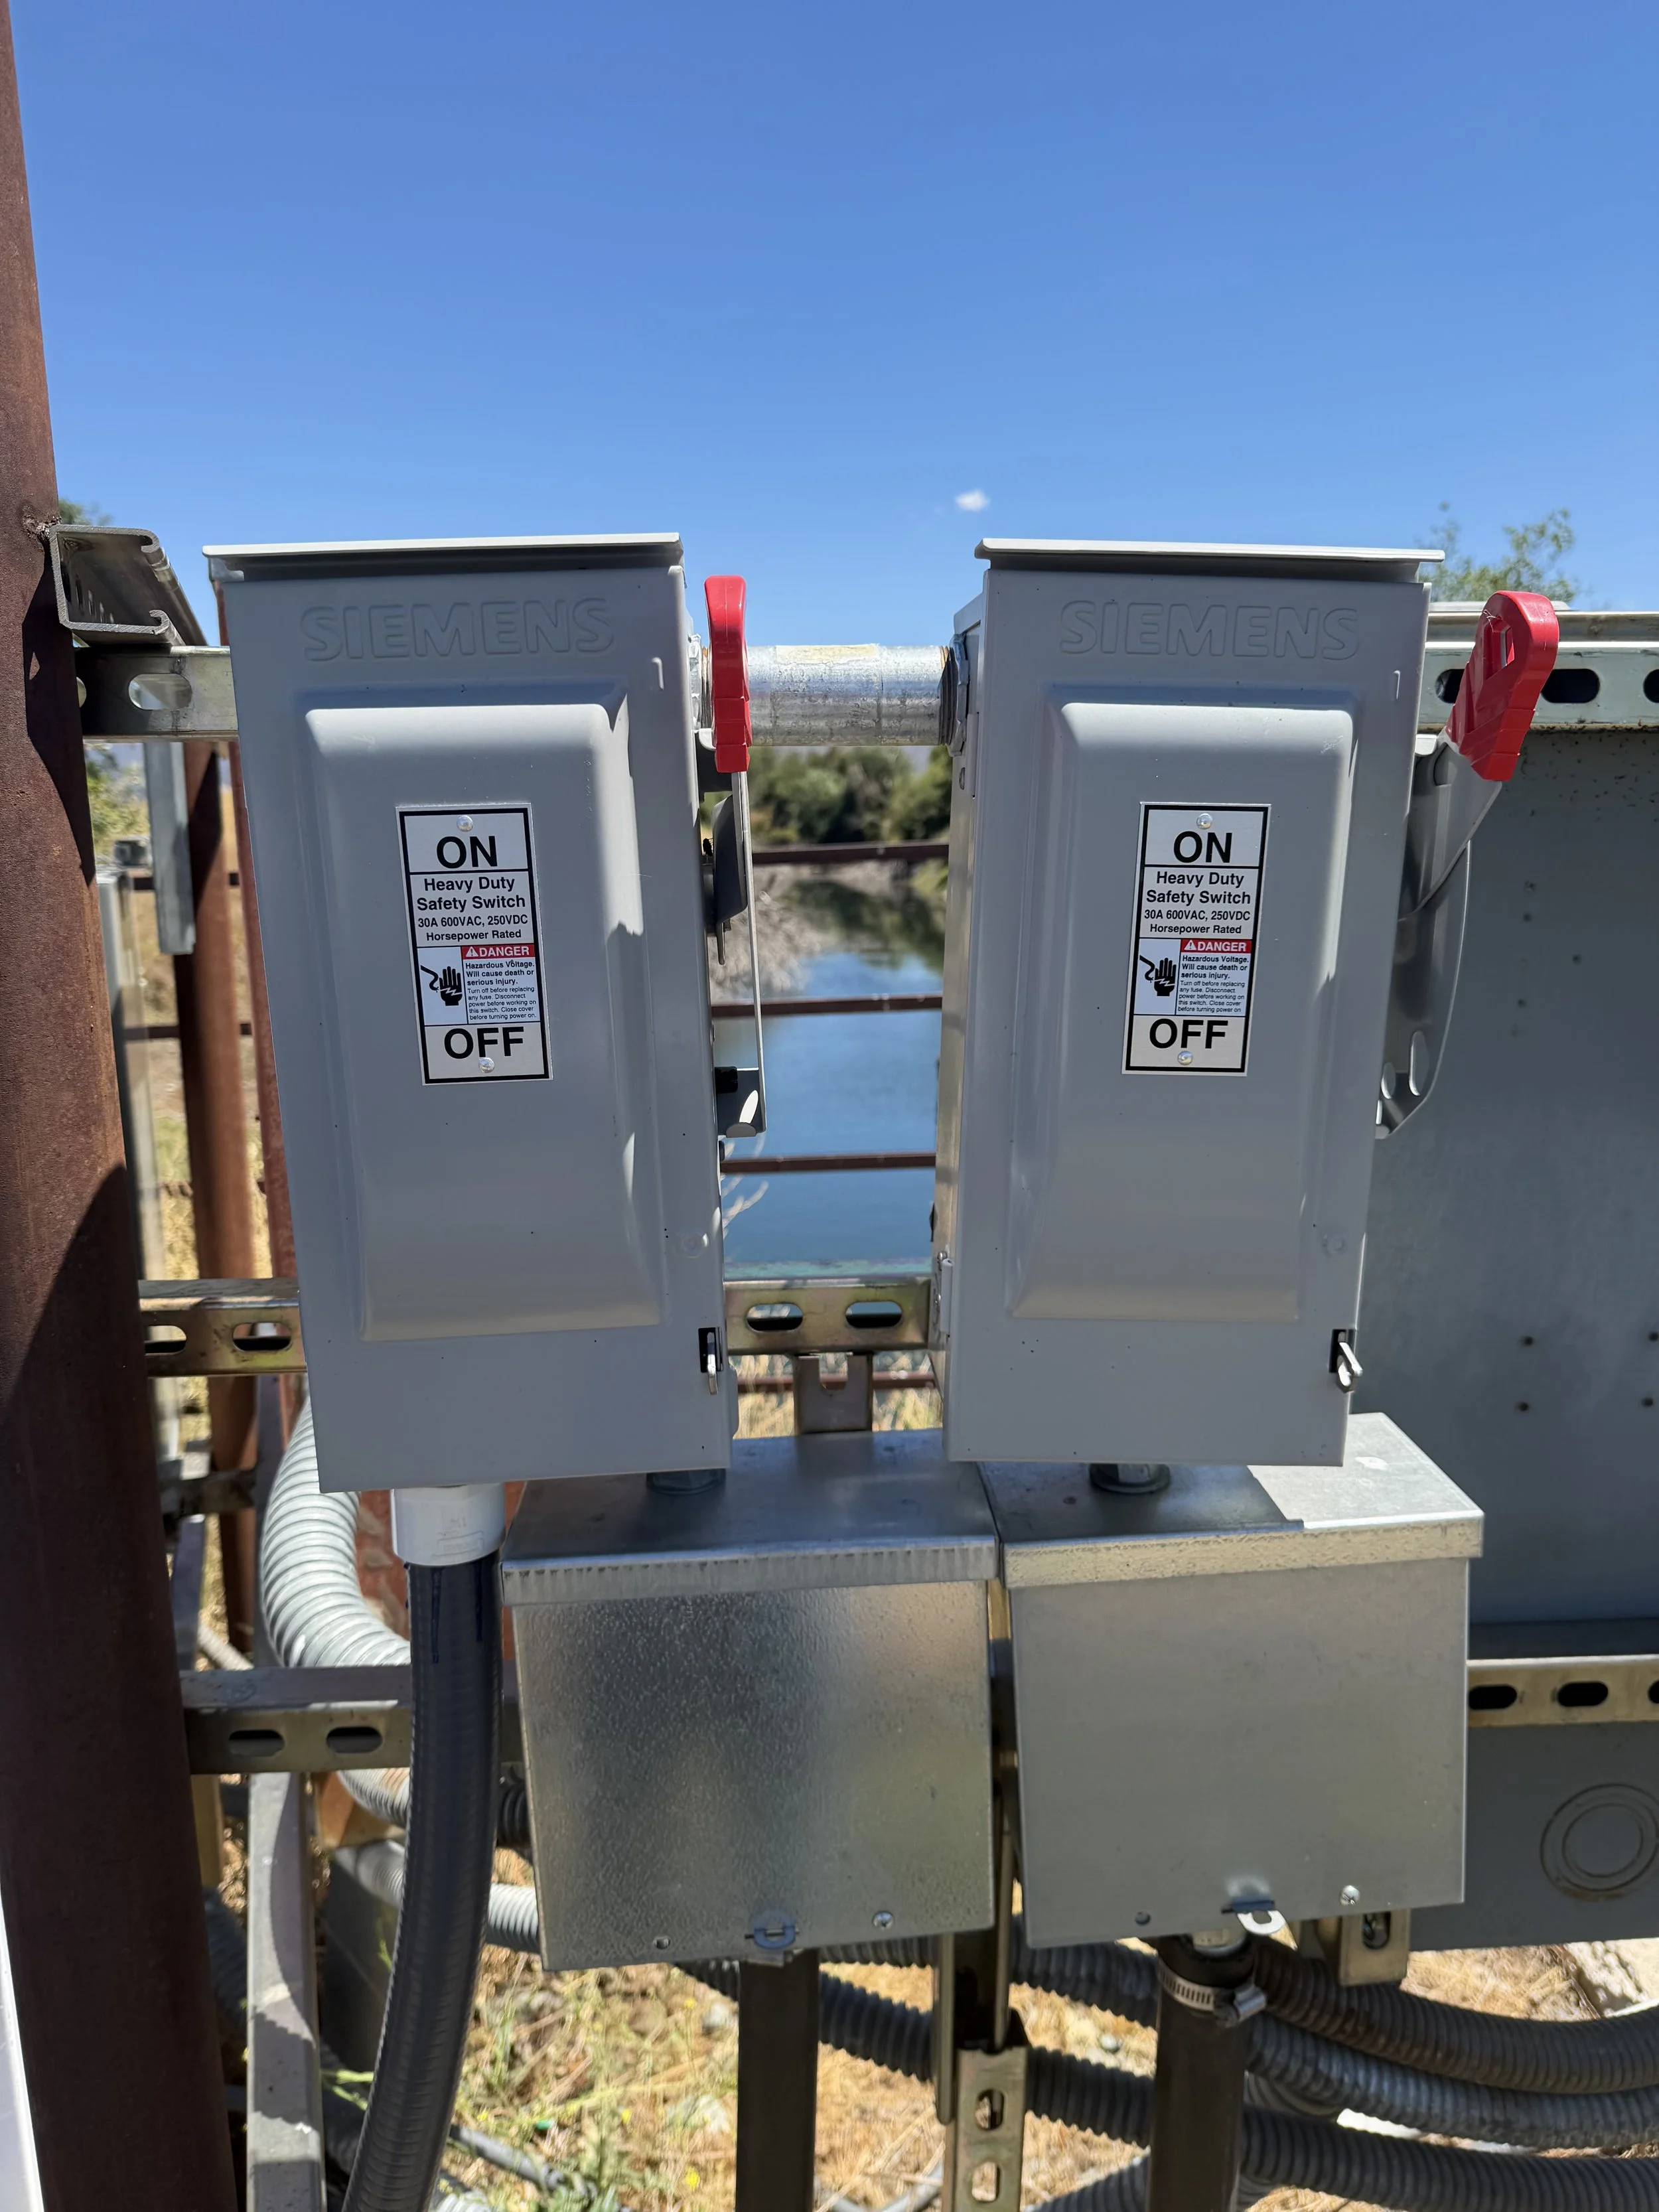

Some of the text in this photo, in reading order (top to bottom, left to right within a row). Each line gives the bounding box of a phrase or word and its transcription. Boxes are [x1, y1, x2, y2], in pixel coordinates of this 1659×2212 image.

[300, 597, 614, 662] SIEMENS
[1060, 601, 1360, 660] SIEMENS
[437, 836, 498, 869] ON
[1174, 831, 1232, 863] ON
[425, 877, 515, 893] Heavy Duty
[1157, 871, 1244, 888] Heavy Duty
[417, 895, 525, 912] Safety Switch
[1147, 890, 1250, 906] Safety Switch
[418, 915, 528, 927] 30A 600VAC, 250VDC
[1145, 910, 1250, 921] 30A 600VAC, 250VDC
[426, 930, 521, 942] Horsepower Rated
[1150, 924, 1242, 934] Horsepower Rated
[479, 946, 529, 956] DANGER
[1198, 942, 1246, 951] DANGER
[1149, 1019, 1228, 1049] OFF
[445, 1027, 524, 1059] OFF
